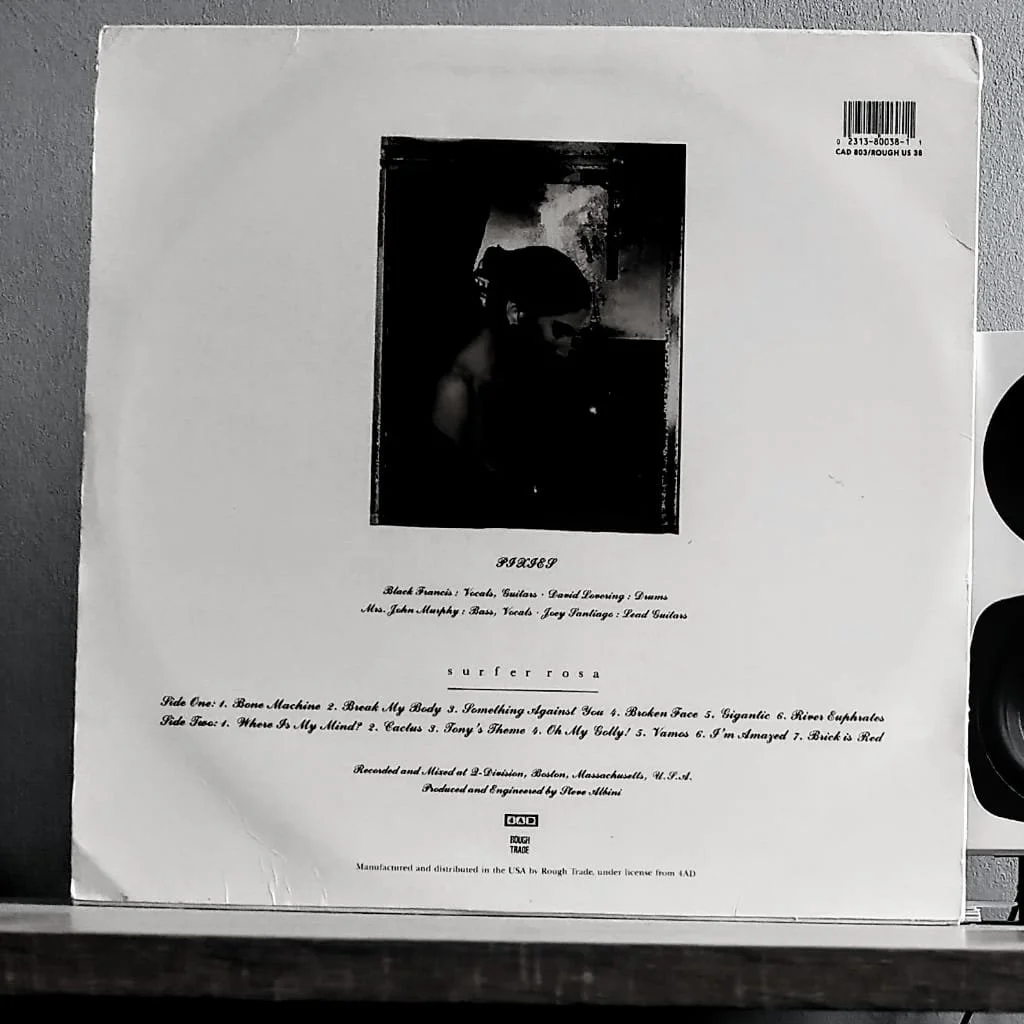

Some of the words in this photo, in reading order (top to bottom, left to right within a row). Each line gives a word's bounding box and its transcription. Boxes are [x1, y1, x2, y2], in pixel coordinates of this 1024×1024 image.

[496, 556, 558, 569] PIXIES
[383, 586, 413, 595] Black
[415, 586, 452, 596] Francis
[463, 588, 497, 598] Vocals,
[501, 588, 538, 598] Guitars
[548, 589, 580, 599] David
[581, 590, 625, 603] Lovering
[634, 591, 669, 600] Drums
[361, 604, 386, 613] Mrs.
[387, 604, 414, 616] John
[416, 605, 460, 618] Murphy
[468, 606, 497, 616] Bass,
[502, 607, 533, 616] Vocals
[541, 607, 566, 620] Joey
[568, 608, 614, 621] Santiago
[622, 609, 650, 618] Lead
[652, 609, 688, 619] Guitars
[448, 666, 532, 677] surfer
[547, 670, 600, 678] rosa
[160, 696, 187, 706] Side
[190, 696, 217, 707] One:
[219, 700, 228, 708] 1.
[232, 698, 265, 709] Bone
[266, 699, 321, 710] Machine
[326, 703, 338, 711] 2.
[342, 700, 380, 712] Break
[381, 702, 406, 716] My
[408, 702, 442, 717] Body
[447, 705, 458, 713] 3.
[462, 703, 525, 719] Something
[526, 705, 578, 719] Against
[581, 706, 605, 716] You
[625, 706, 668, 717] Broken
[669, 707, 699, 718] Face
[721, 708, 771, 723] Gigantic
[776, 712, 787, 720] 6.
[791, 710, 824, 721] River
[826, 710, 885, 725] Euphrates
[160, 715, 186, 726] Side
[189, 715, 219, 727] Two:
[236, 717, 274, 728] Where
[276, 718, 291, 729] Is
[293, 719, 318, 734] My
[320, 720, 363, 731] Mind?
[367, 723, 379, 731] 2.
[383, 721, 423, 732] Cactus
[428, 724, 439, 733] 3.
[443, 722, 484, 738] Tony's
[486, 723, 526, 734] Theme
[546, 725, 563, 735] Oh
[564, 725, 589, 740] My
[593, 725, 632, 740] Golly!
[635, 729, 647, 737] 5.
[652, 727, 690, 737] Vamos
[695, 730, 706, 738] 6.
[709, 727, 735, 739] I'm
[737, 729, 790, 744] Amazed
[792, 733, 803, 741] 7.
[807, 730, 840, 741] Brick
[842, 733, 853, 741] is
[857, 731, 886, 742] Red
[352, 764, 400, 774] Recorded
[400, 766, 421, 775] and
[422, 766, 456, 776] Mixed
[456, 768, 468, 776] at
[530, 769, 570, 779] Boston,
[572, 769, 648, 780] Massachusetts,
[422, 783, 468, 793] Produced
[468, 784, 488, 793] and
[489, 784, 544, 797] Engineered
[544, 786, 558, 798] by
[560, 786, 587, 795] Steve
[588, 787, 623, 796] Albini
[510, 835, 531, 845] ROUGH
[510, 846, 530, 855] TRADE
[356, 863, 414, 871] Manufactured
[434, 865, 479, 873] distributed
[492, 866, 506, 874] the
[508, 866, 527, 874] USA
[541, 867, 568, 877] Rough
[570, 868, 595, 876] Trade,
[624, 868, 653, 876] license
